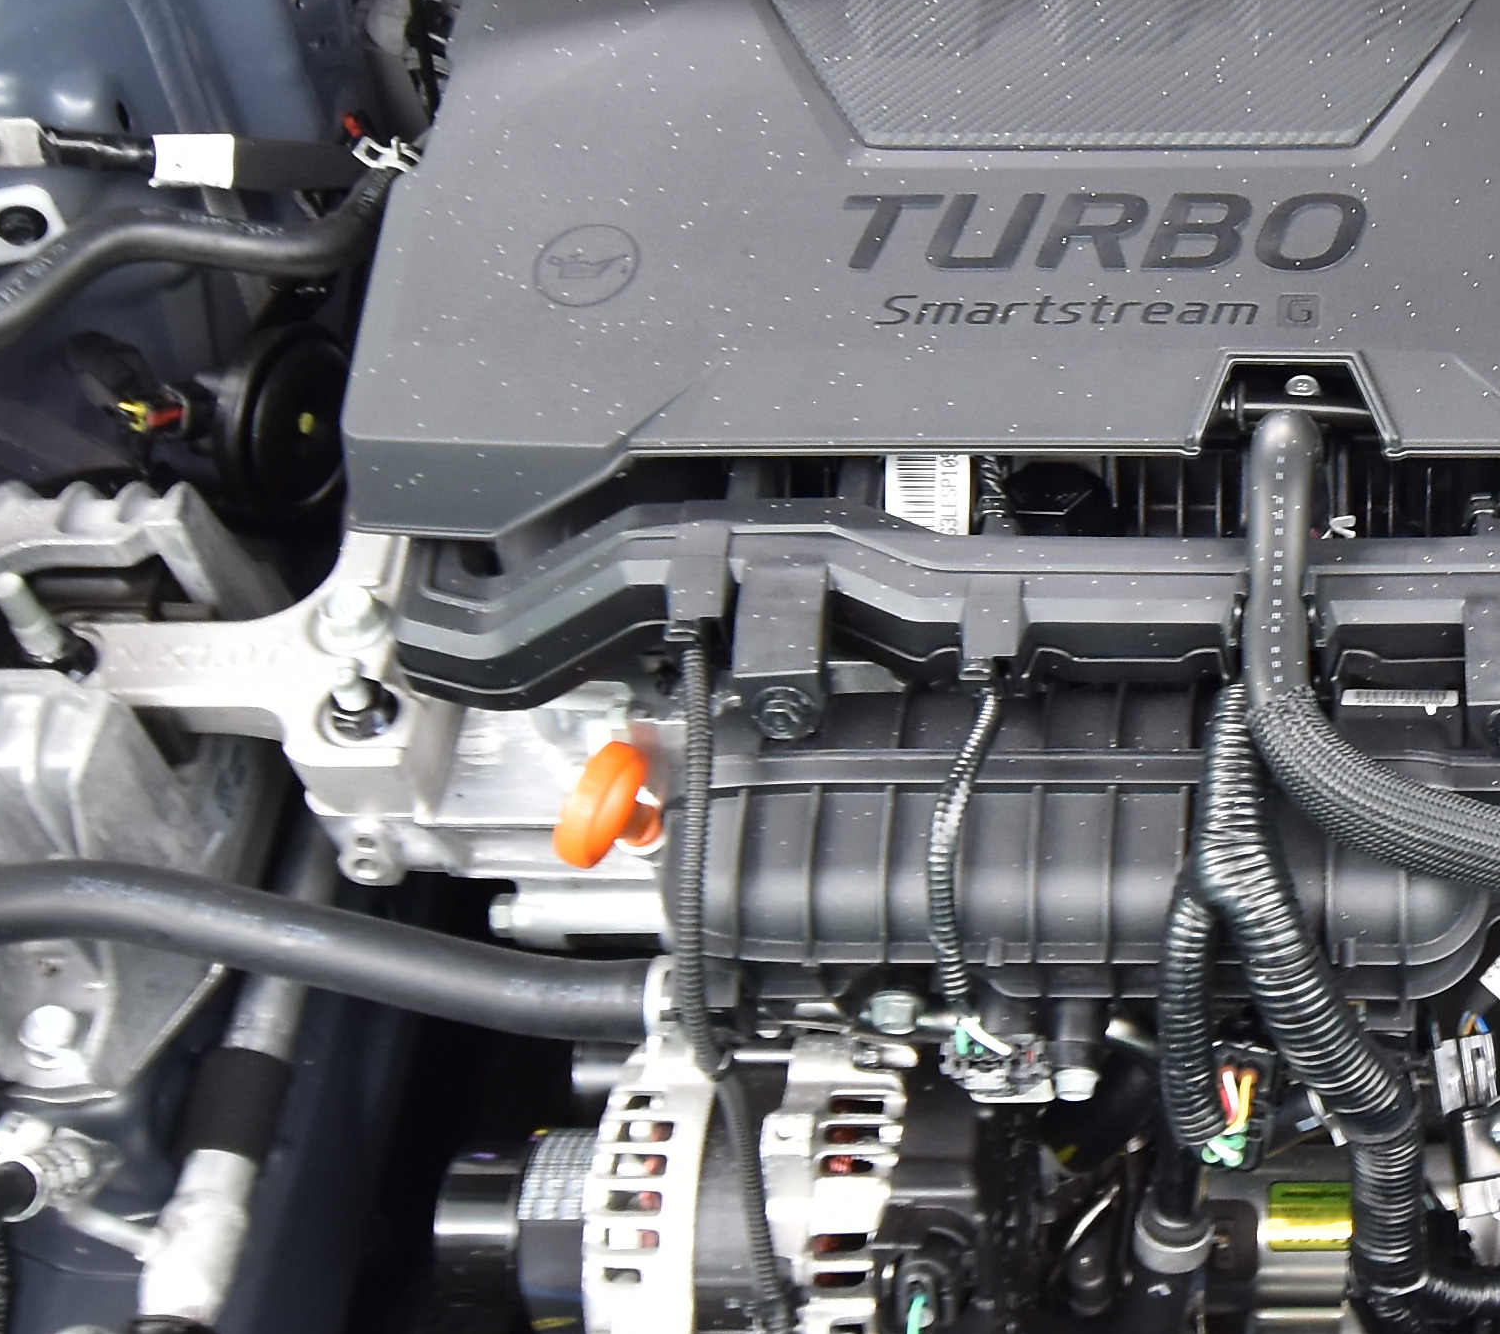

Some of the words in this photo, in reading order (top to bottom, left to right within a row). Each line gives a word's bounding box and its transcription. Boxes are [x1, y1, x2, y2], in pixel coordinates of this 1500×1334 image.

[843, 192, 1367, 271] TURBO
[874, 294, 1260, 325] Smartstream
[1281, 296, 1317, 327] G
